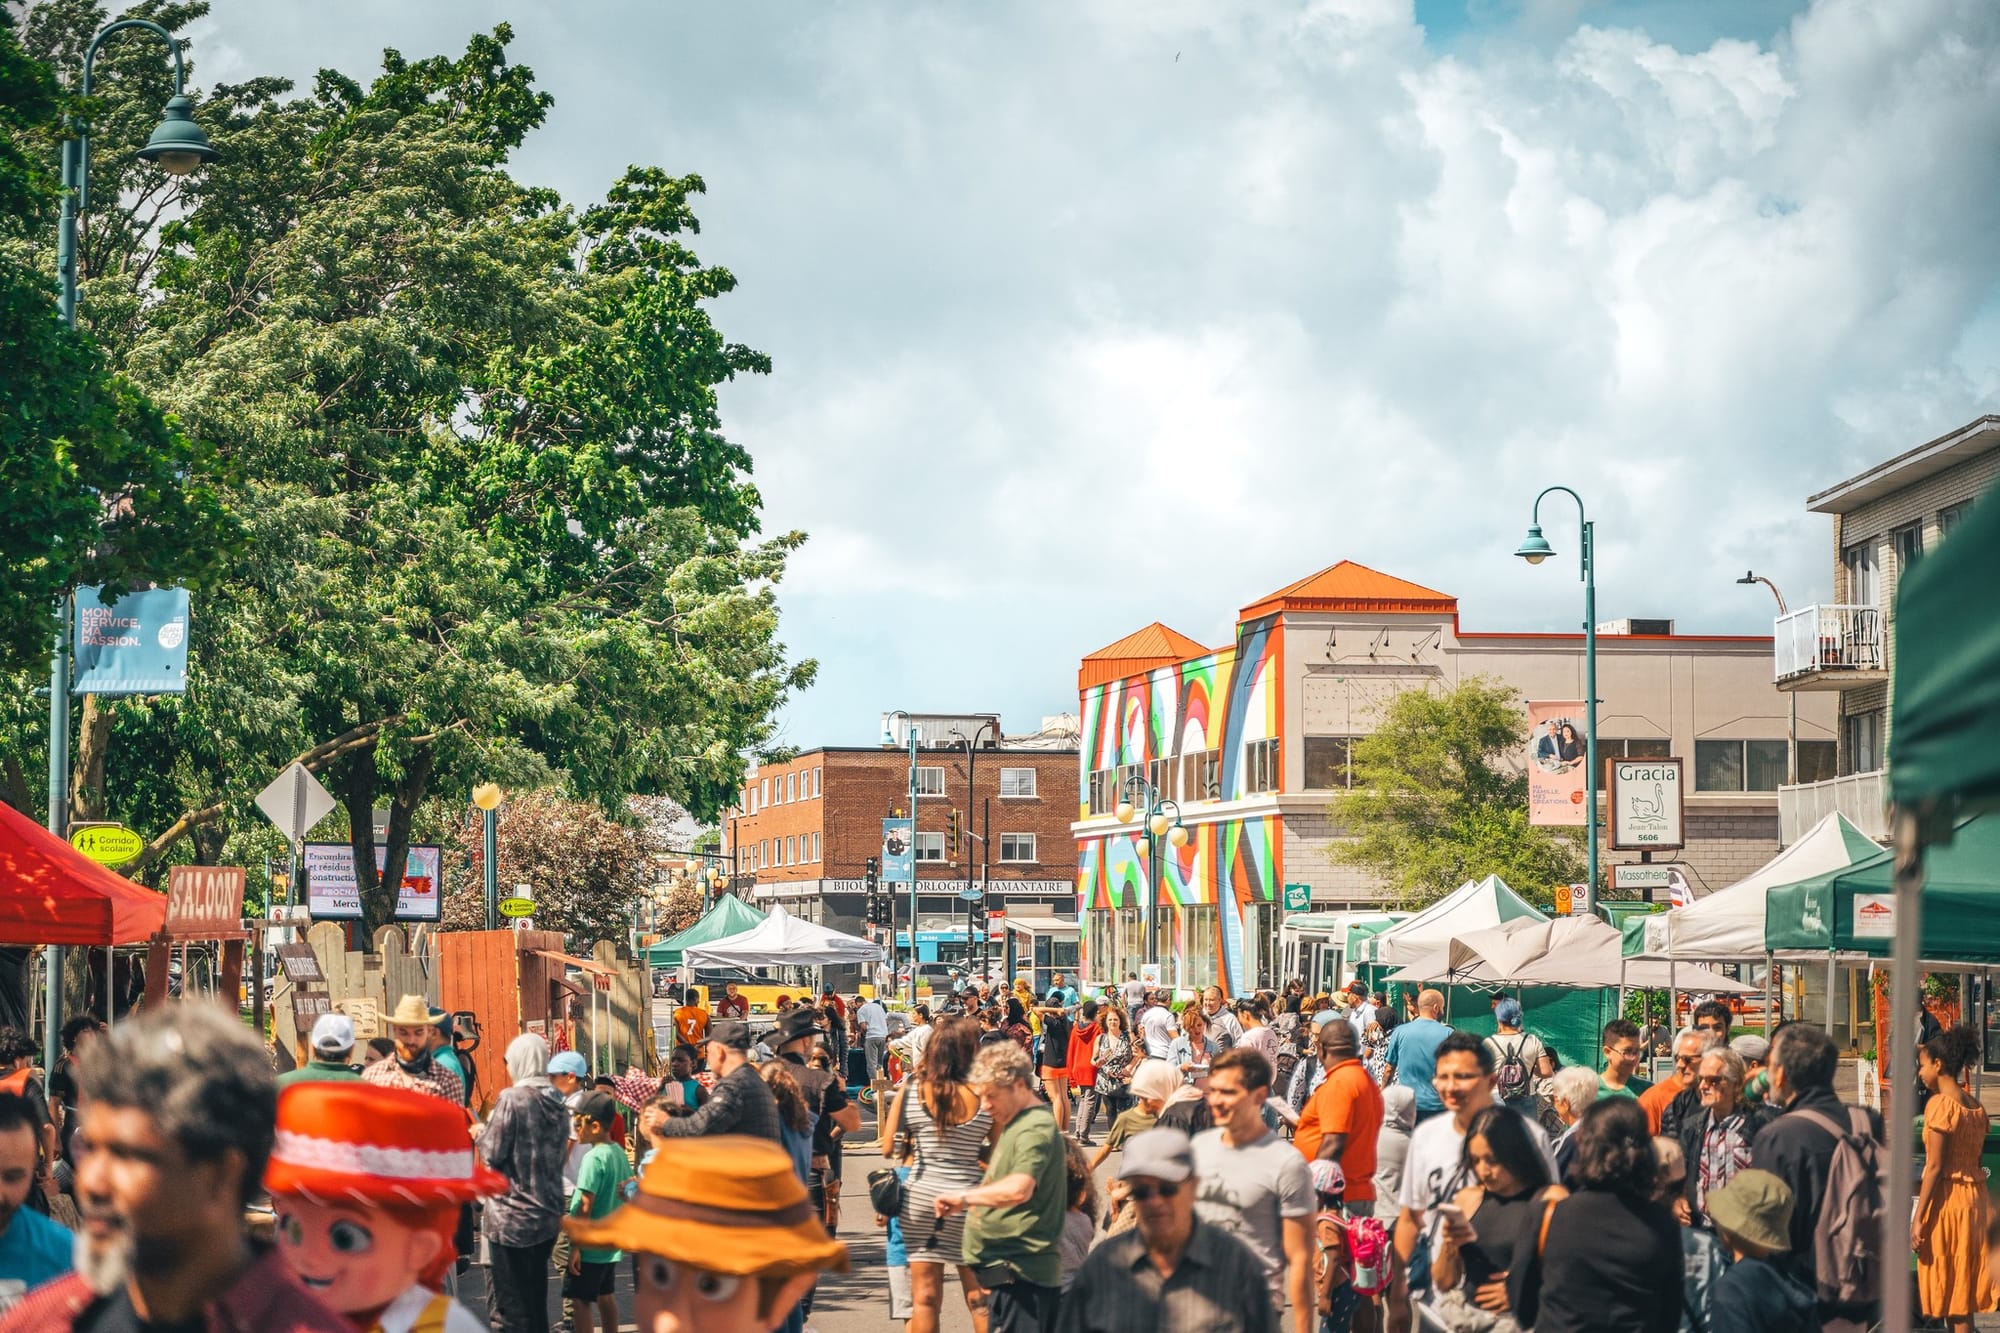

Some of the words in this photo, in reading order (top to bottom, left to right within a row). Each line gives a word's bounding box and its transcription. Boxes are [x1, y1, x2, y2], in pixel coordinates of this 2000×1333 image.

[82, 608, 112, 617] MON
[82, 618, 141, 629] SERVICE,
[82, 627, 101, 636] MA
[82, 636, 141, 646] PASSION.
[1619, 765, 1675, 781] Gracia
[99, 836, 136, 845] Corridor
[99, 845, 134, 853] scolaire
[309, 852, 352, 860] Encombra
[319, 862, 351, 871] résidus
[1617, 870, 1668, 881] Massothera
[989, 881, 1063, 892] IAMANTAIRE
[169, 872, 239, 920] SALOON
[333, 899, 360, 908] Mercr
[687, 1019, 696, 1035] 7
